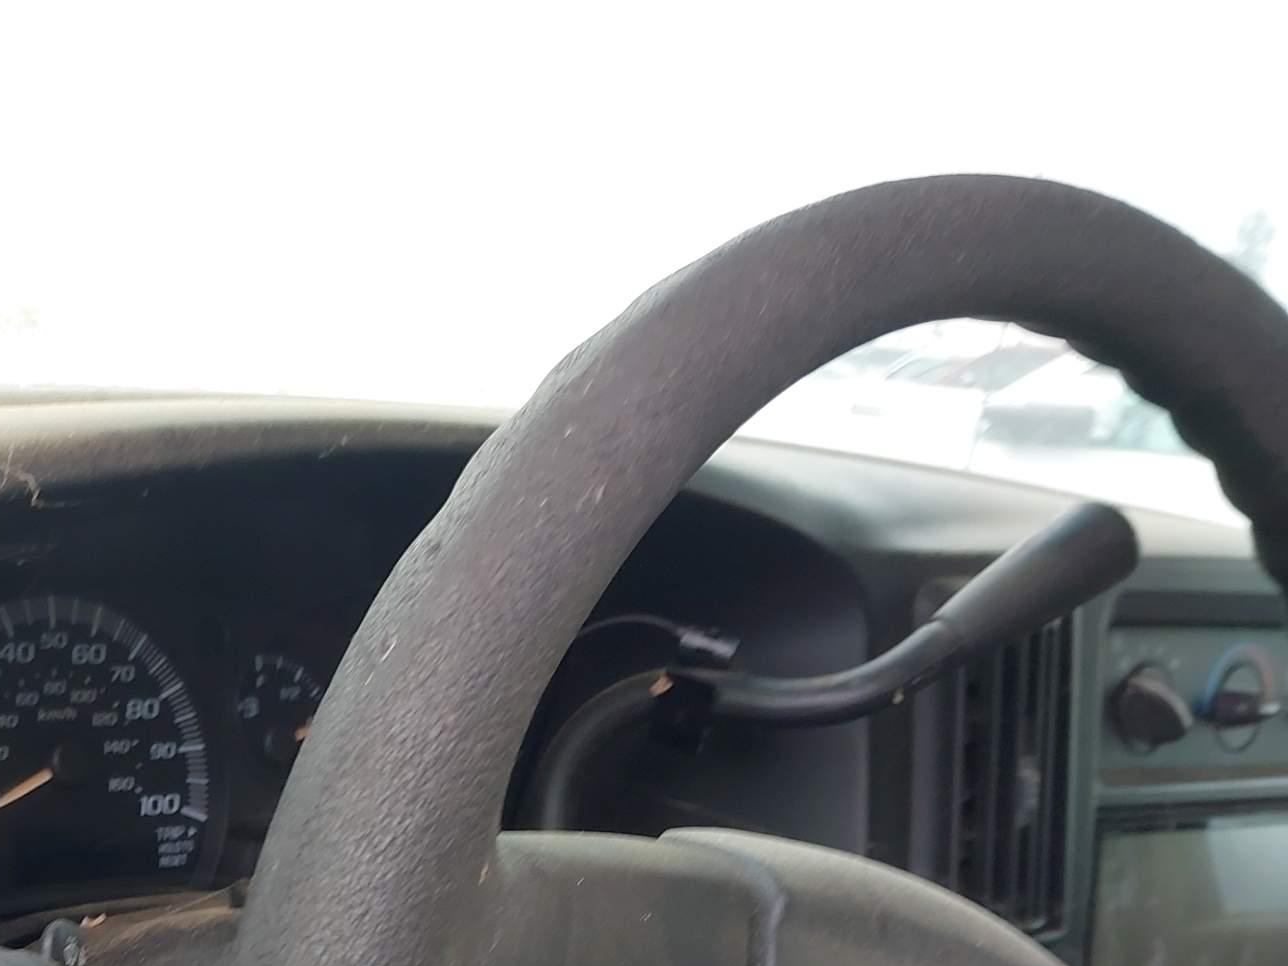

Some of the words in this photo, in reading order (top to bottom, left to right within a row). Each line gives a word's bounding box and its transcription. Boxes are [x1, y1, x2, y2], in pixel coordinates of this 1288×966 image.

[40, 631, 68, 651] 50
[72, 642, 107, 665] 60
[110, 665, 136, 683] 70
[124, 698, 161, 720] 80
[92, 712, 118, 727] 120
[103, 738, 131, 755] 140
[149, 741, 177, 760] 90
[138, 793, 181, 817] 100
